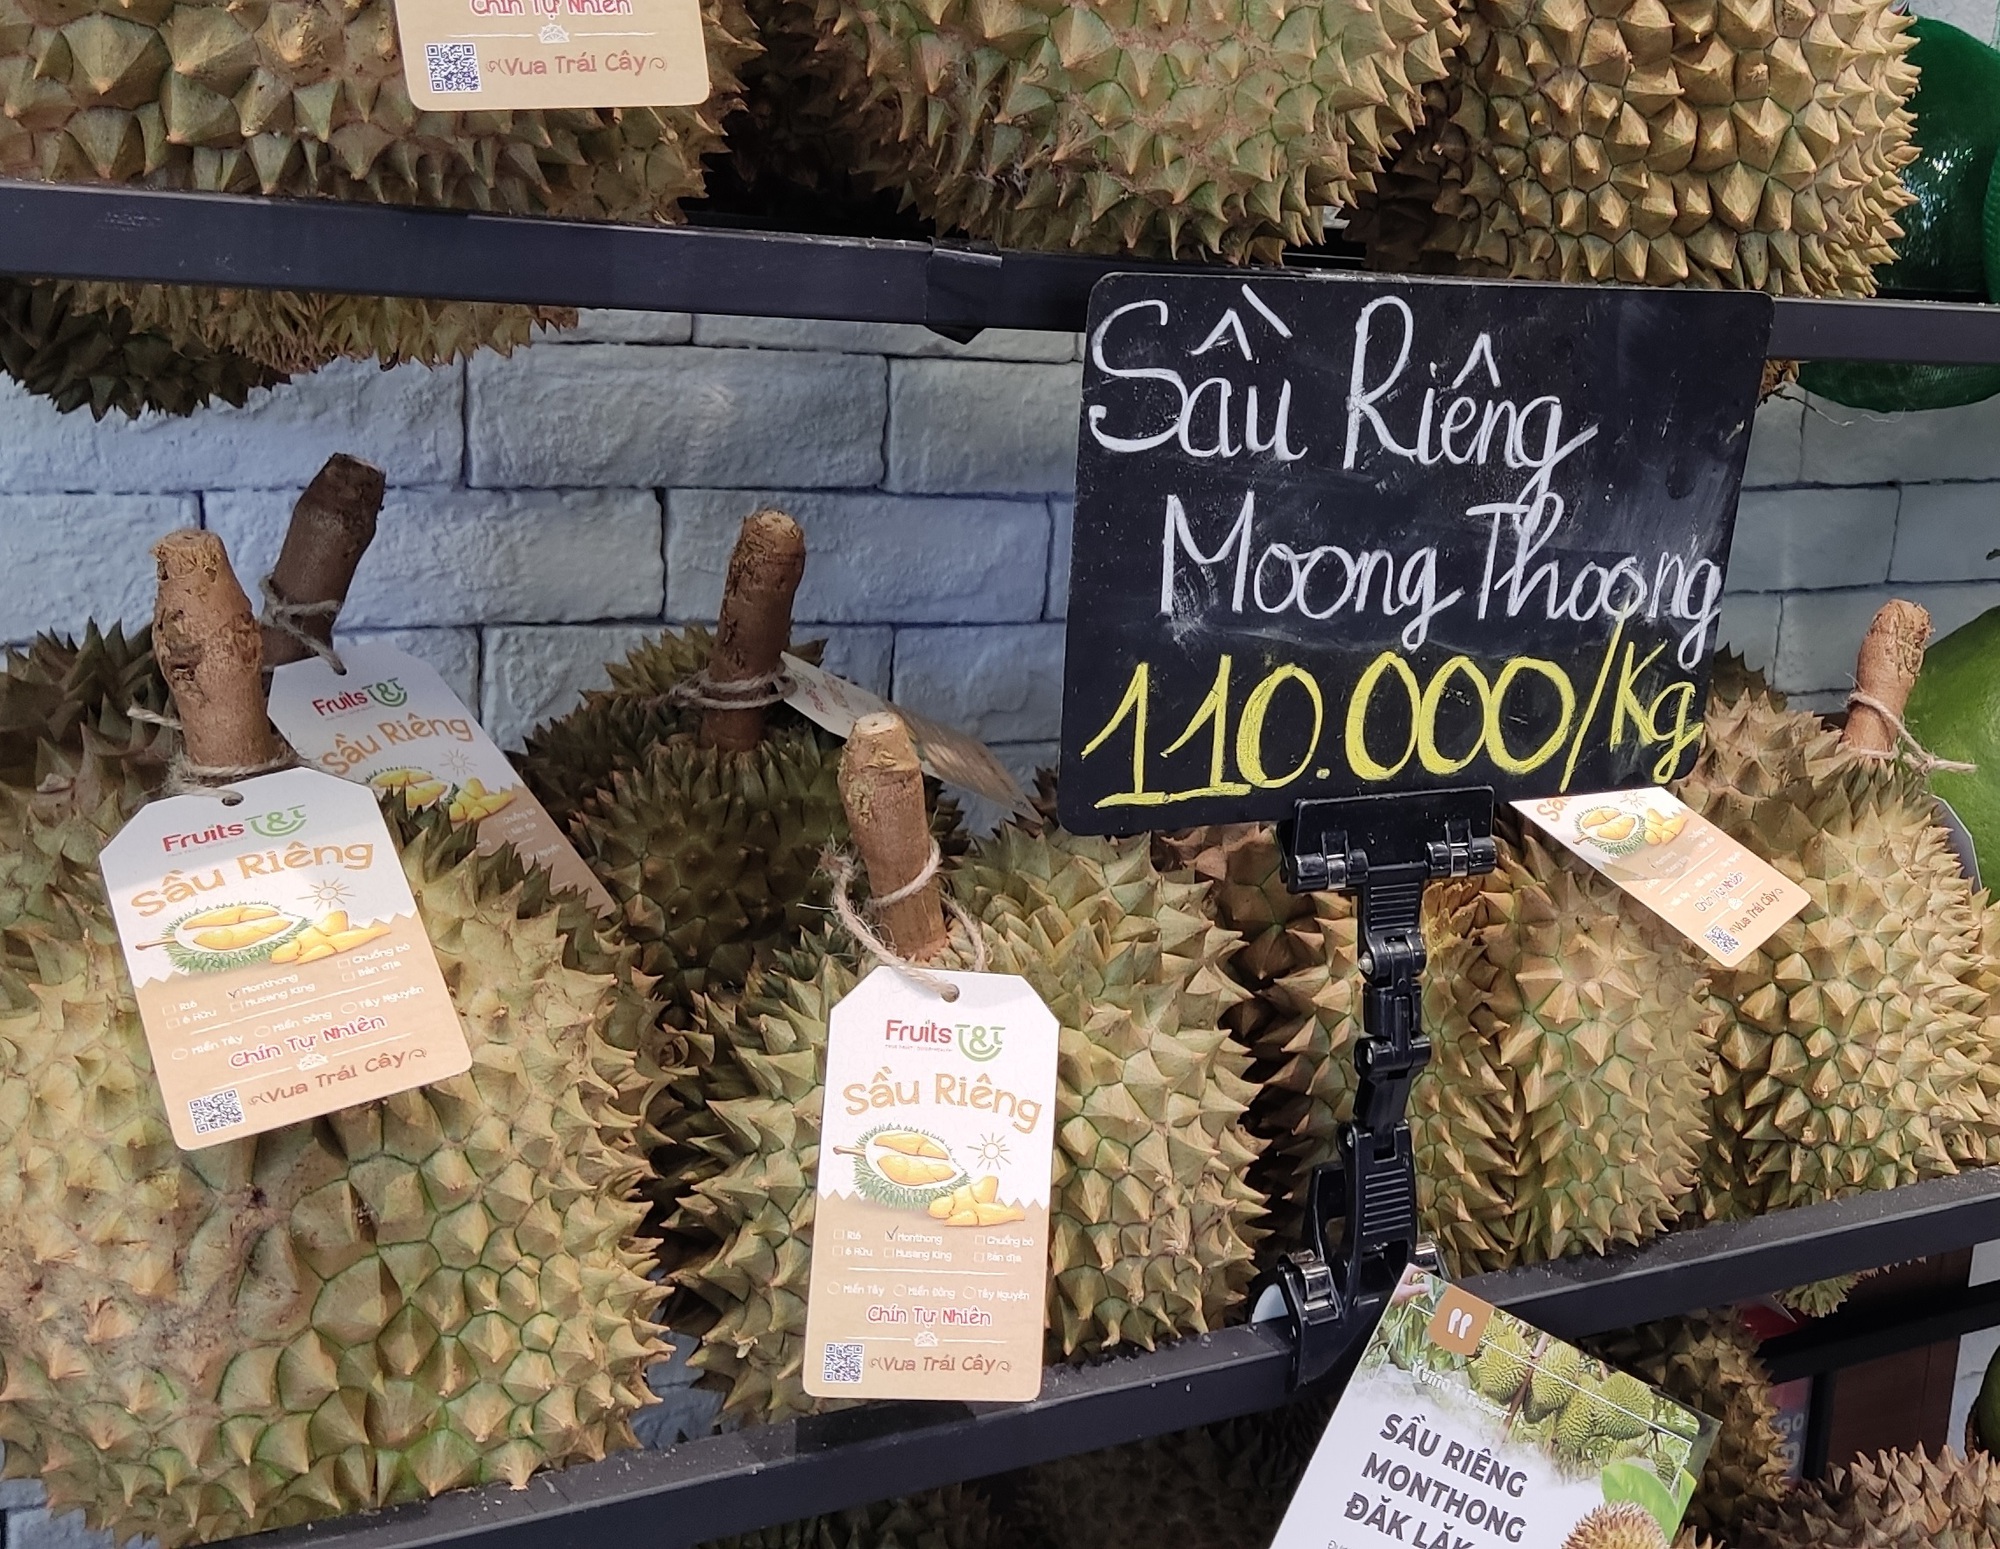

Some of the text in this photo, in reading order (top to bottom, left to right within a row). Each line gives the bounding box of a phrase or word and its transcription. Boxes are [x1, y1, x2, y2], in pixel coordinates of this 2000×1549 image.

[504, 50, 647, 76] Vua Trái Cây
[1088, 284, 1598, 534] Sầu Riêng
[1160, 491, 1723, 672] Moong Thoong
[312, 691, 368, 716] Fruits
[321, 733, 383, 775] Sầu
[377, 712, 474, 747] Riêng
[162, 823, 245, 852] Fruits
[131, 869, 226, 917] Sầu
[236, 841, 374, 879] Riêng
[241, 973, 299, 994] Monthong
[244, 982, 316, 1007] Musang King
[229, 1016, 387, 1068] Chín Tự Nhiên
[885, 1019, 953, 1044] Fruits
[266, 1051, 406, 1100] Vua Trái Cây
[843, 1066, 1043, 1134] Sầu Riêng
[895, 1249, 953, 1262] Musang King
[897, 1233, 943, 1246] Monthong
[867, 1304, 992, 1328] Chín Tự Nhiên
[883, 1353, 996, 1375] Vua Trái Cây
[1379, 1413, 1529, 1498] SẦU RIÊNG
[1344, 1491, 1413, 1541] ĐĂK
[1361, 1451, 1527, 1543] MONTHONG
